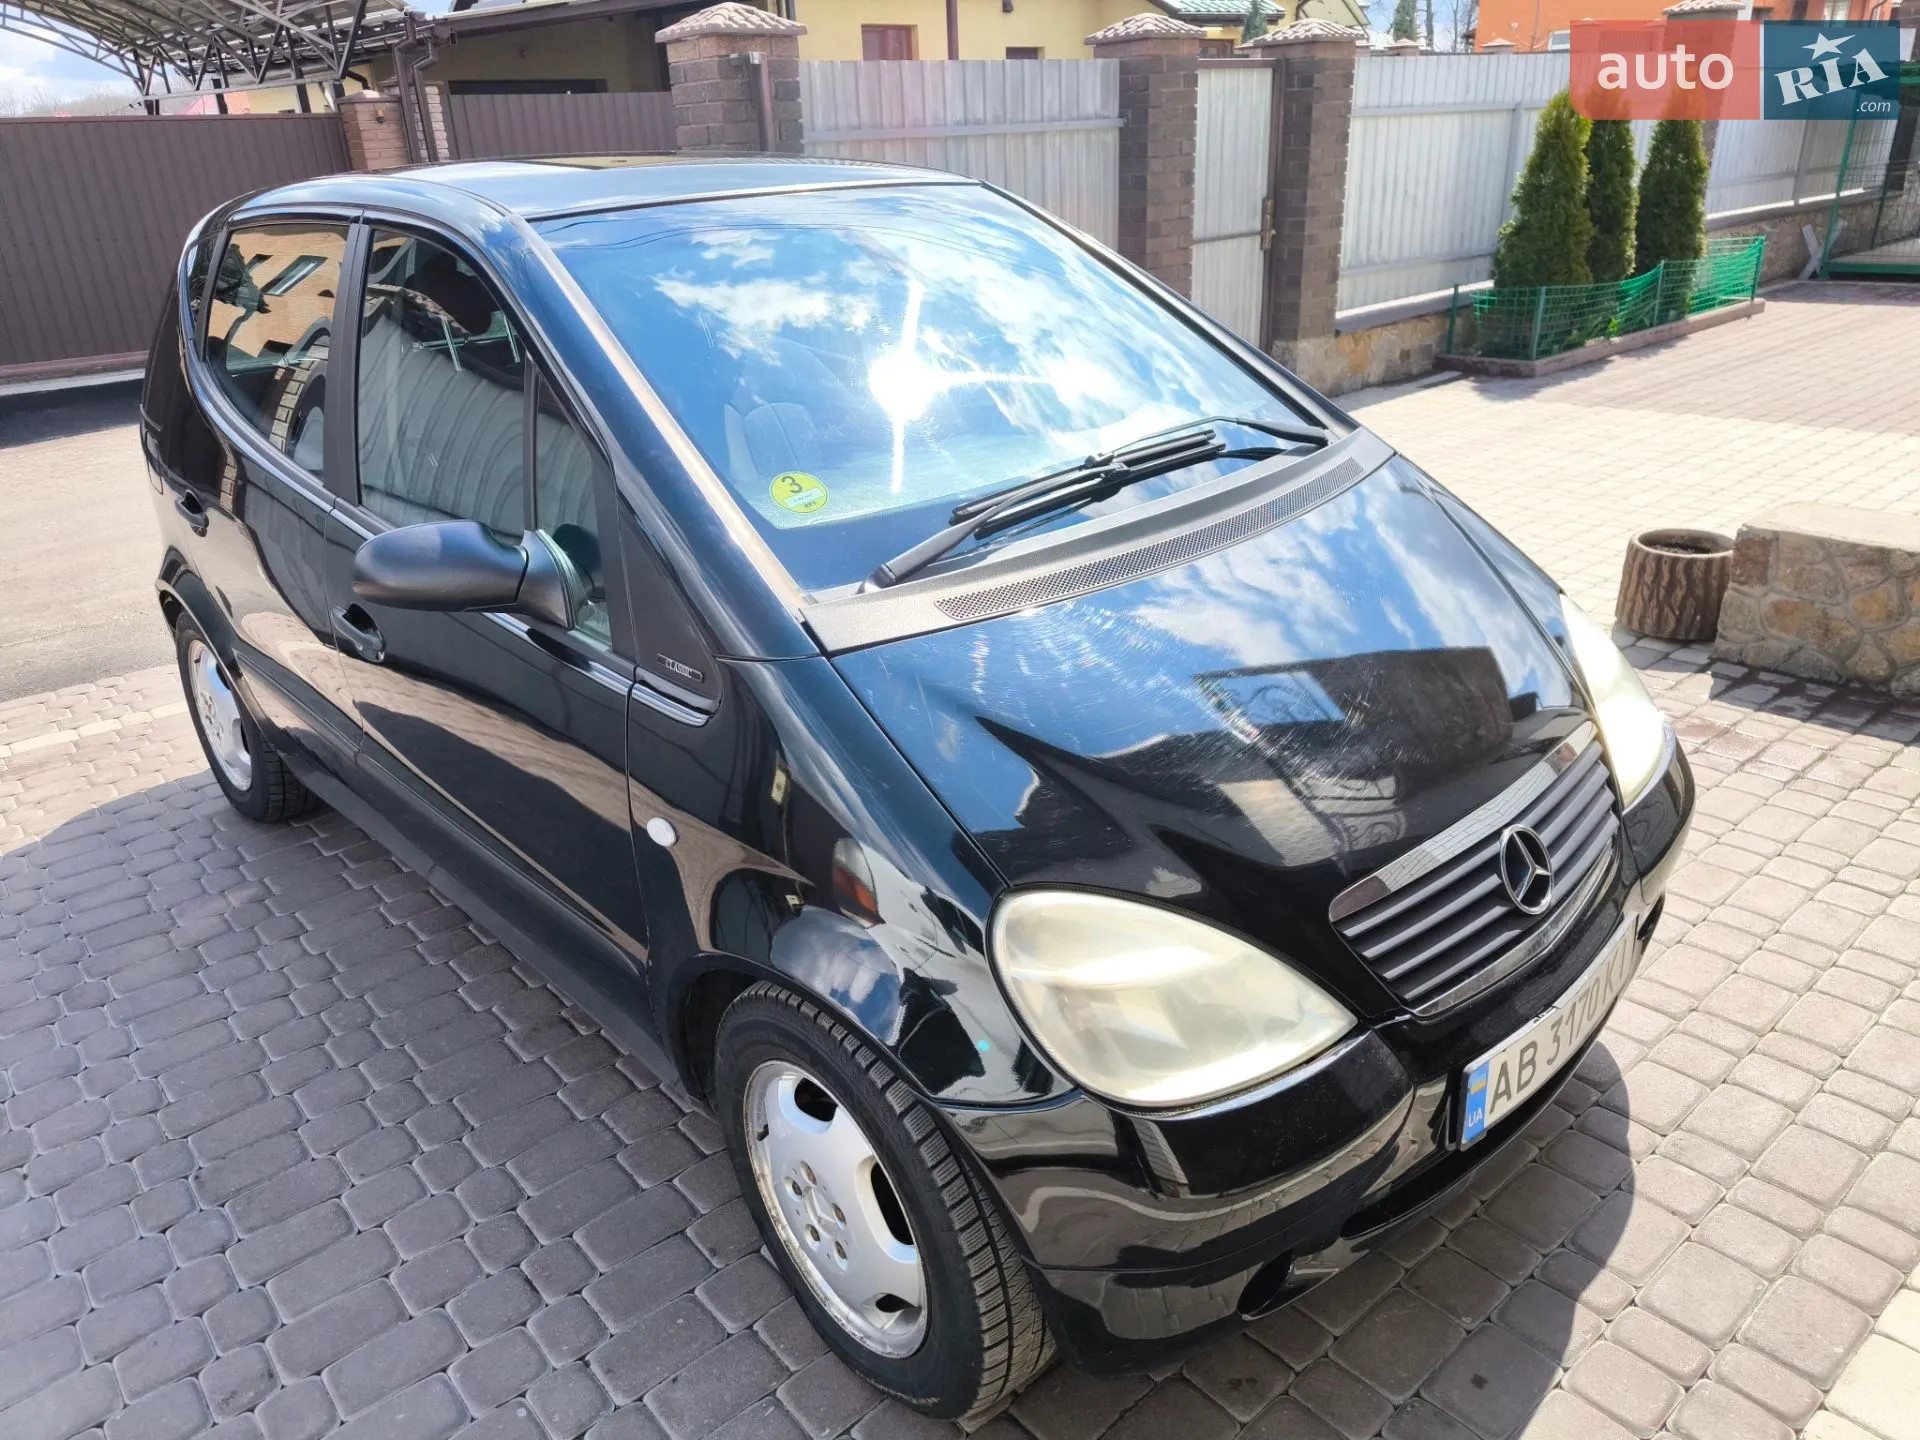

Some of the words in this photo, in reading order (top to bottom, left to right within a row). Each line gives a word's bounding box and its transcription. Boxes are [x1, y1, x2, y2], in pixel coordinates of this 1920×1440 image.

[781, 475, 802, 493] 3
[1488, 1040, 1538, 1115] AB
[1547, 976, 1600, 1066] 3170
[1468, 1109, 1484, 1128] UA
